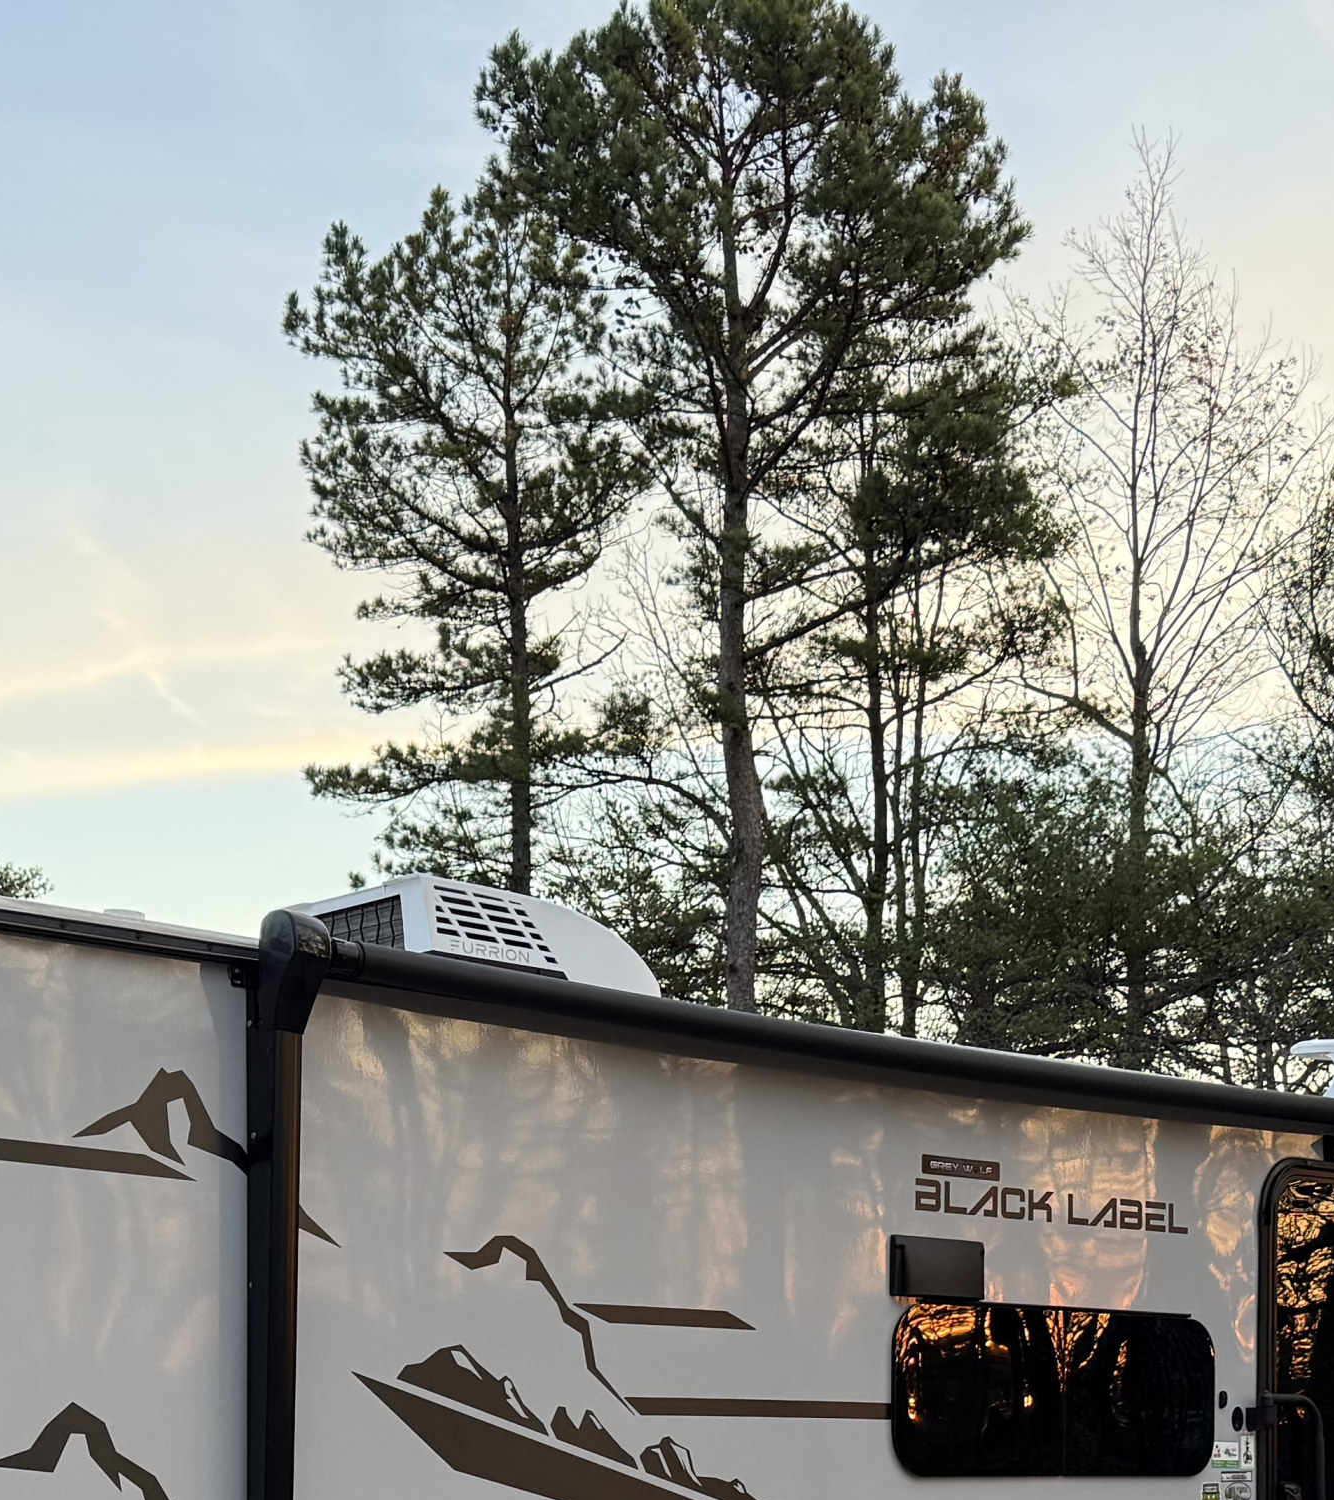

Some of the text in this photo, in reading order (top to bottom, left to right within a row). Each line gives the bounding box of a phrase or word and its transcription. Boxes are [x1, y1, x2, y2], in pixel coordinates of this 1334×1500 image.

[450, 939, 530, 963] FURRION
[930, 1160, 993, 1175] GREY WLF
[915, 1177, 1188, 1235] BLACK LABEL
